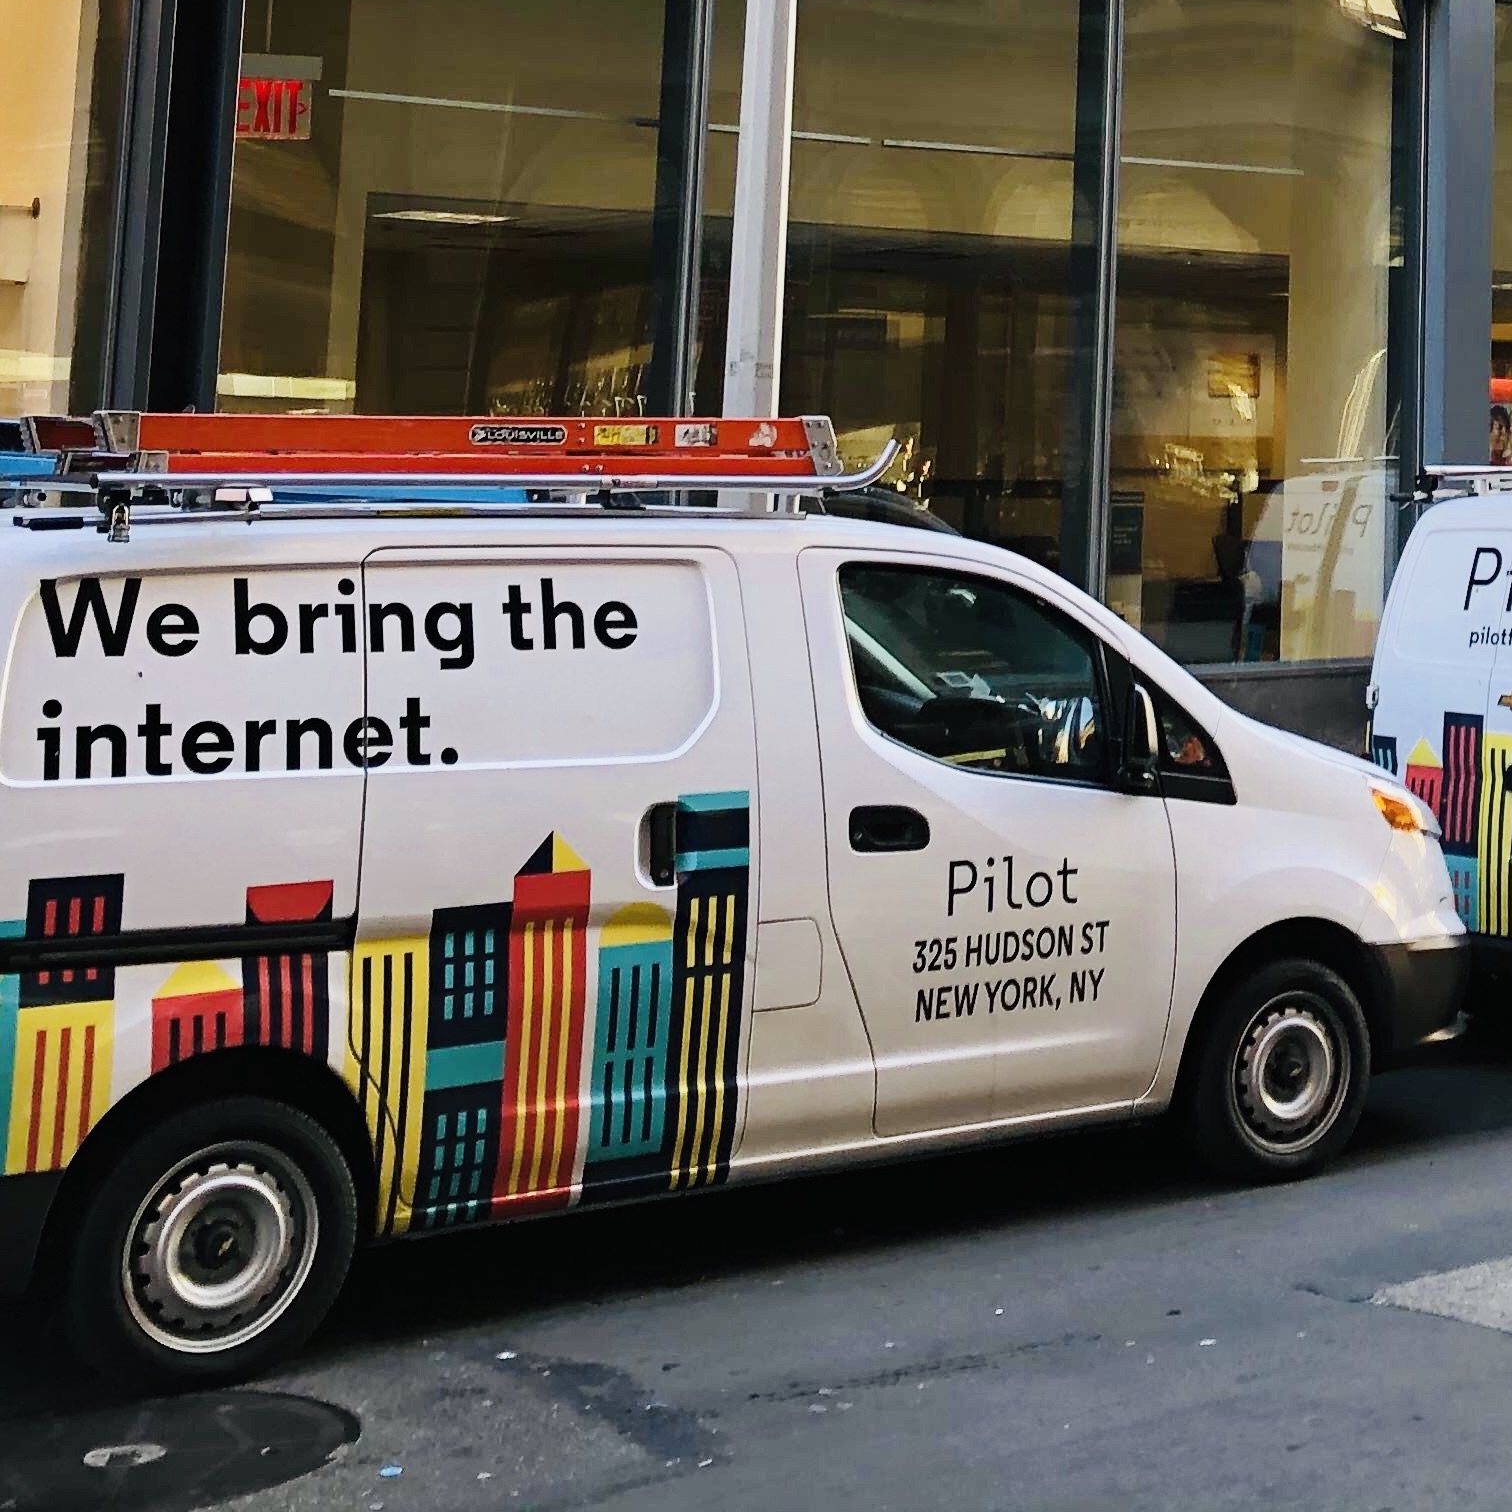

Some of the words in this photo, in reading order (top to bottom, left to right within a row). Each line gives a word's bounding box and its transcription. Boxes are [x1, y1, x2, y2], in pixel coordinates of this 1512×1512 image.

[237, 79, 304, 134] EXIT
[487, 430, 564, 441] LOUISVILLE
[39, 578, 200, 658] We
[233, 577, 475, 670] bring
[502, 577, 639, 651] the
[36, 696, 459, 781] internet.
[947, 855, 1079, 917] Pilot
[912, 936, 958, 974] 325
[965, 924, 1074, 968] HUDSON
[1080, 919, 1111, 955] ST
[914, 982, 980, 1023] NEW
[984, 972, 1062, 1014] YORK,
[1069, 967, 1106, 1004] NY
